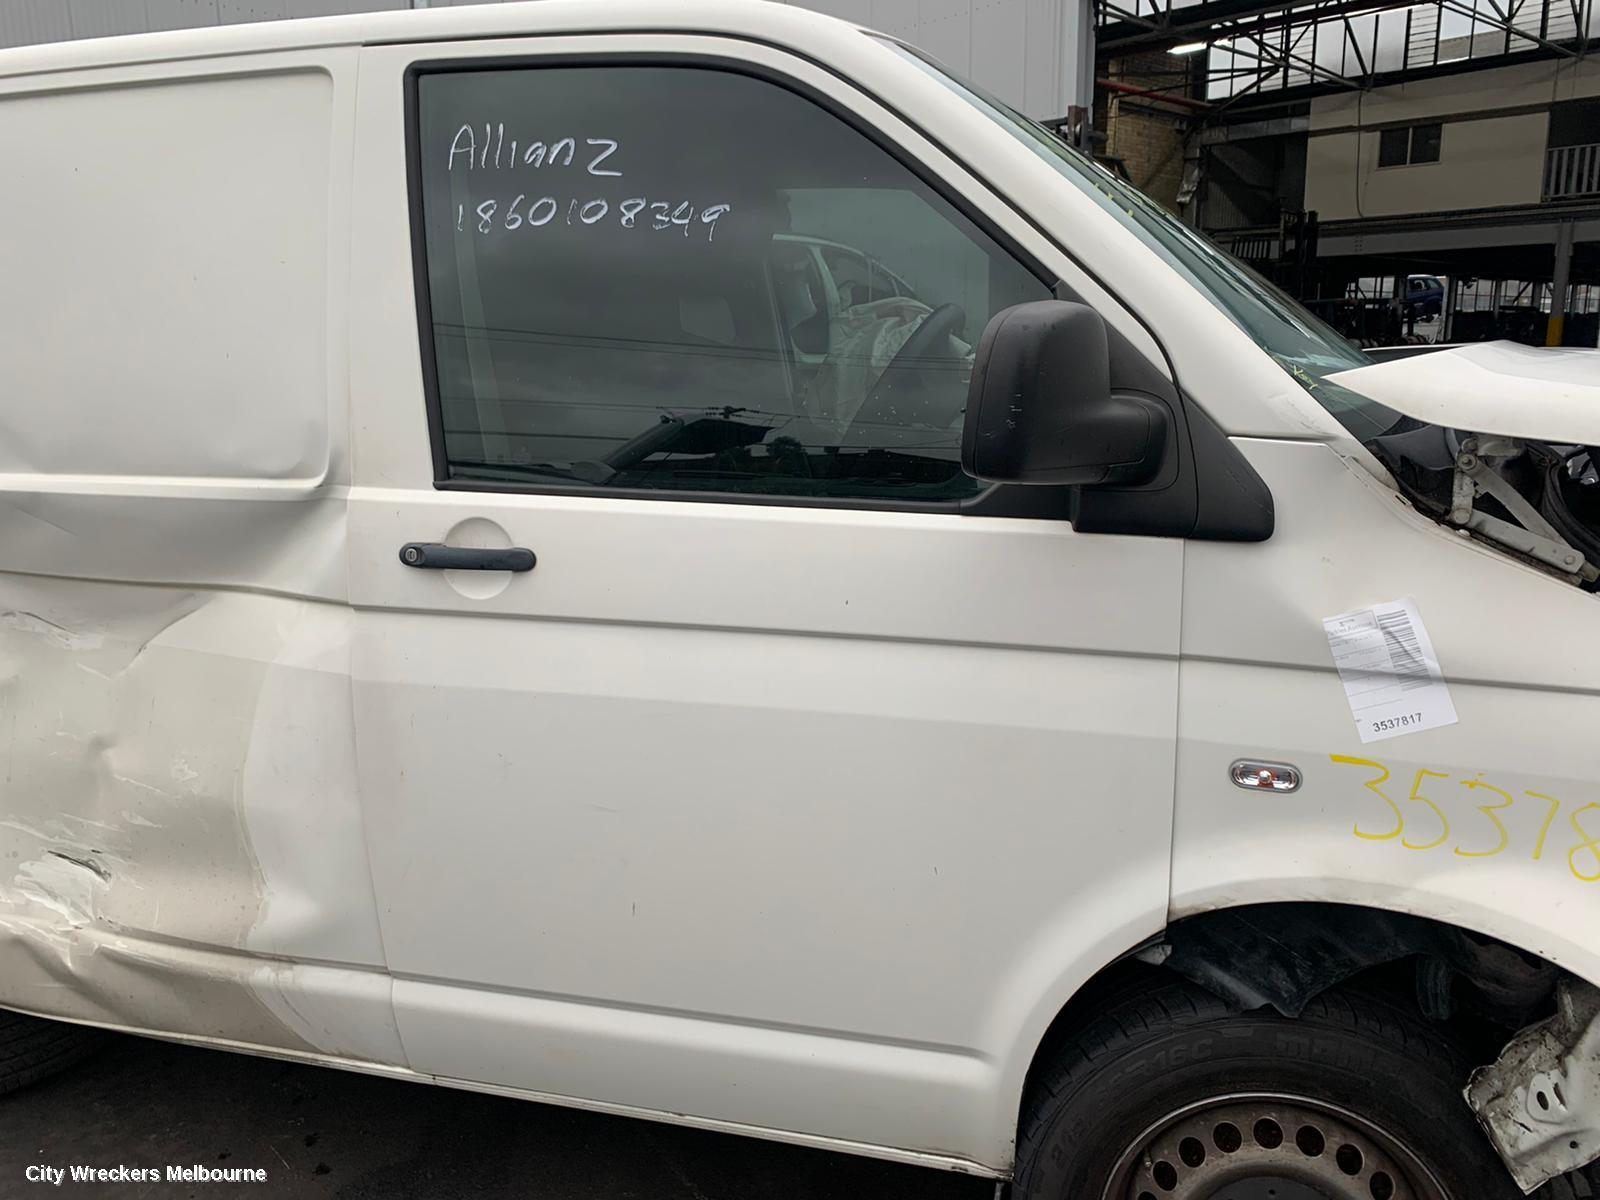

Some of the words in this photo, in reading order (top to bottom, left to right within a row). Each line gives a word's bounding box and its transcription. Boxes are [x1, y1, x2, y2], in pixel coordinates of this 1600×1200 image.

[457, 195, 731, 242] 1860108349
[1372, 712, 1423, 733] 3537817
[1328, 753, 1600, 882] 35378
